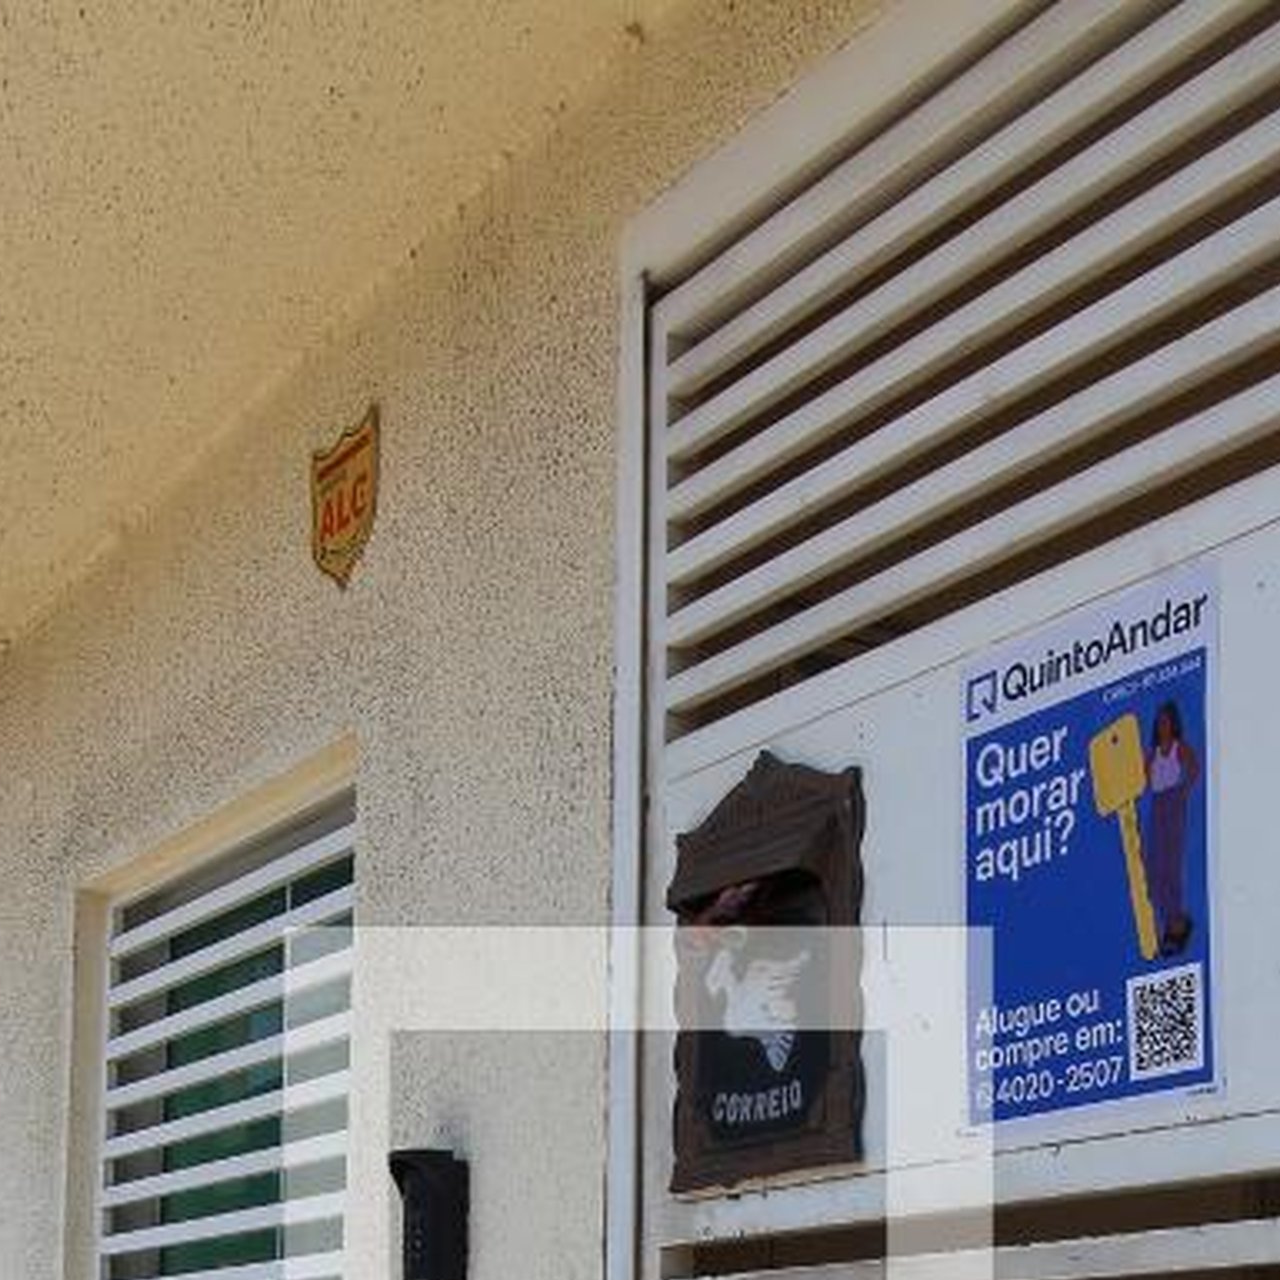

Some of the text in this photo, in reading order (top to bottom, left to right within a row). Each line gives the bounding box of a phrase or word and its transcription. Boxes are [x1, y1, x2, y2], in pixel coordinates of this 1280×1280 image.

[1002, 594, 1208, 701] QuintoAndar
[976, 725, 1068, 788] Quer
[976, 768, 1085, 835] morar
[976, 810, 1075, 881] aqui?
[976, 988, 1099, 1037] Alugue ou
[976, 1019, 1123, 1071] compre em:
[712, 1079, 803, 1123] CORREIO
